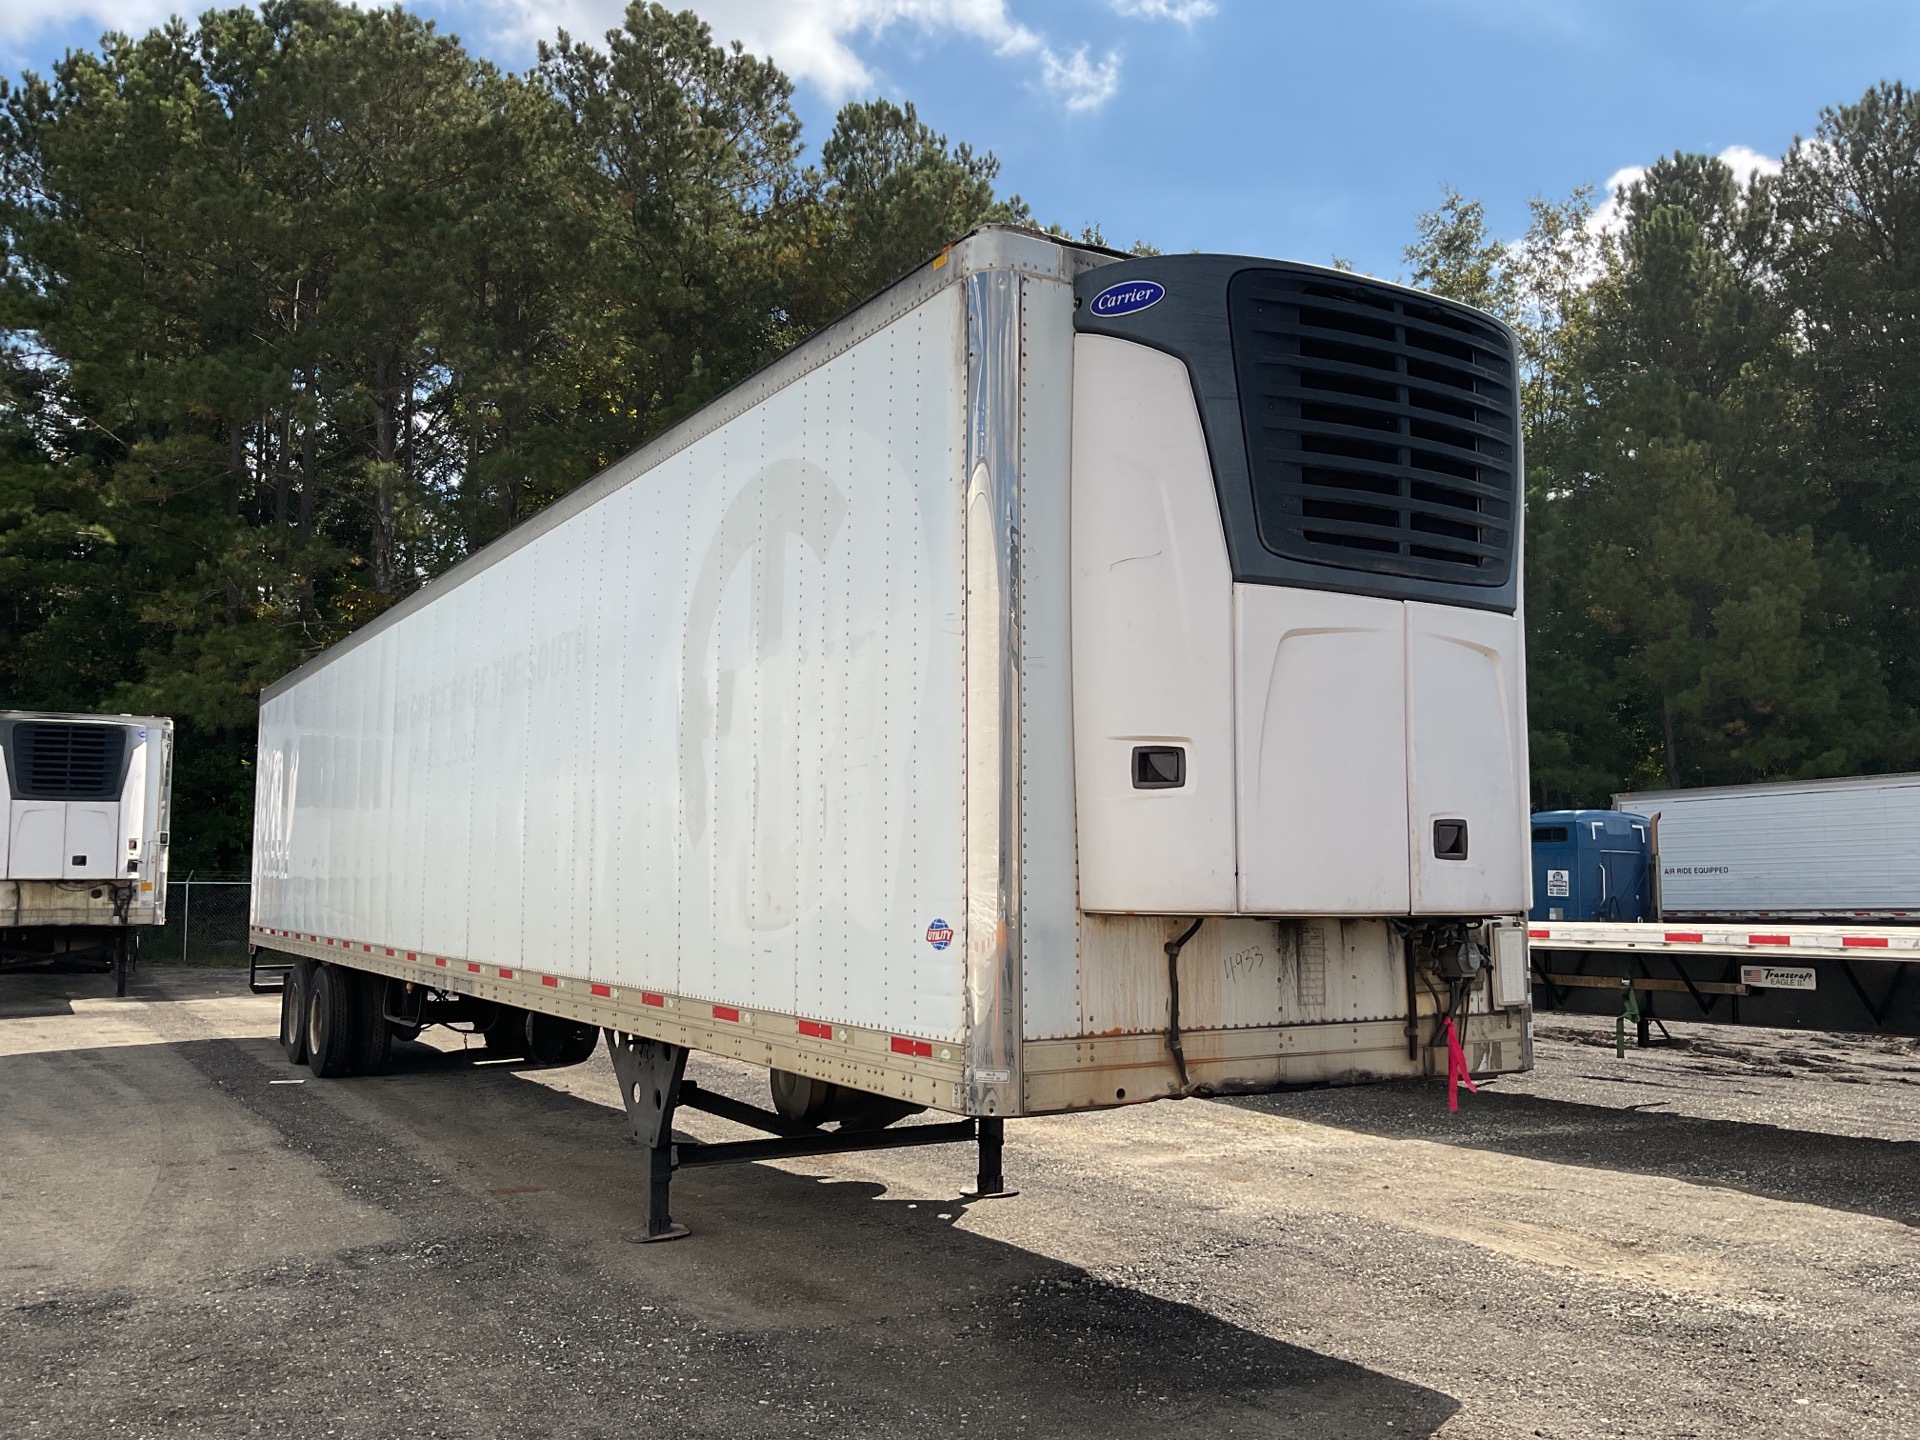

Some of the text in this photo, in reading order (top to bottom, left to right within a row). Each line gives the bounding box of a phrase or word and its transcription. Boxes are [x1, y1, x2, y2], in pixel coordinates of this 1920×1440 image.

[1098, 288, 1154, 310] Carrier
[528, 624, 589, 687] SOUTH
[1664, 867, 1675, 875] AIR
[1694, 866, 1729, 874] EQUIPPED
[928, 930, 952, 941] UTILITY
[1763, 968, 1813, 982] Transcraft
